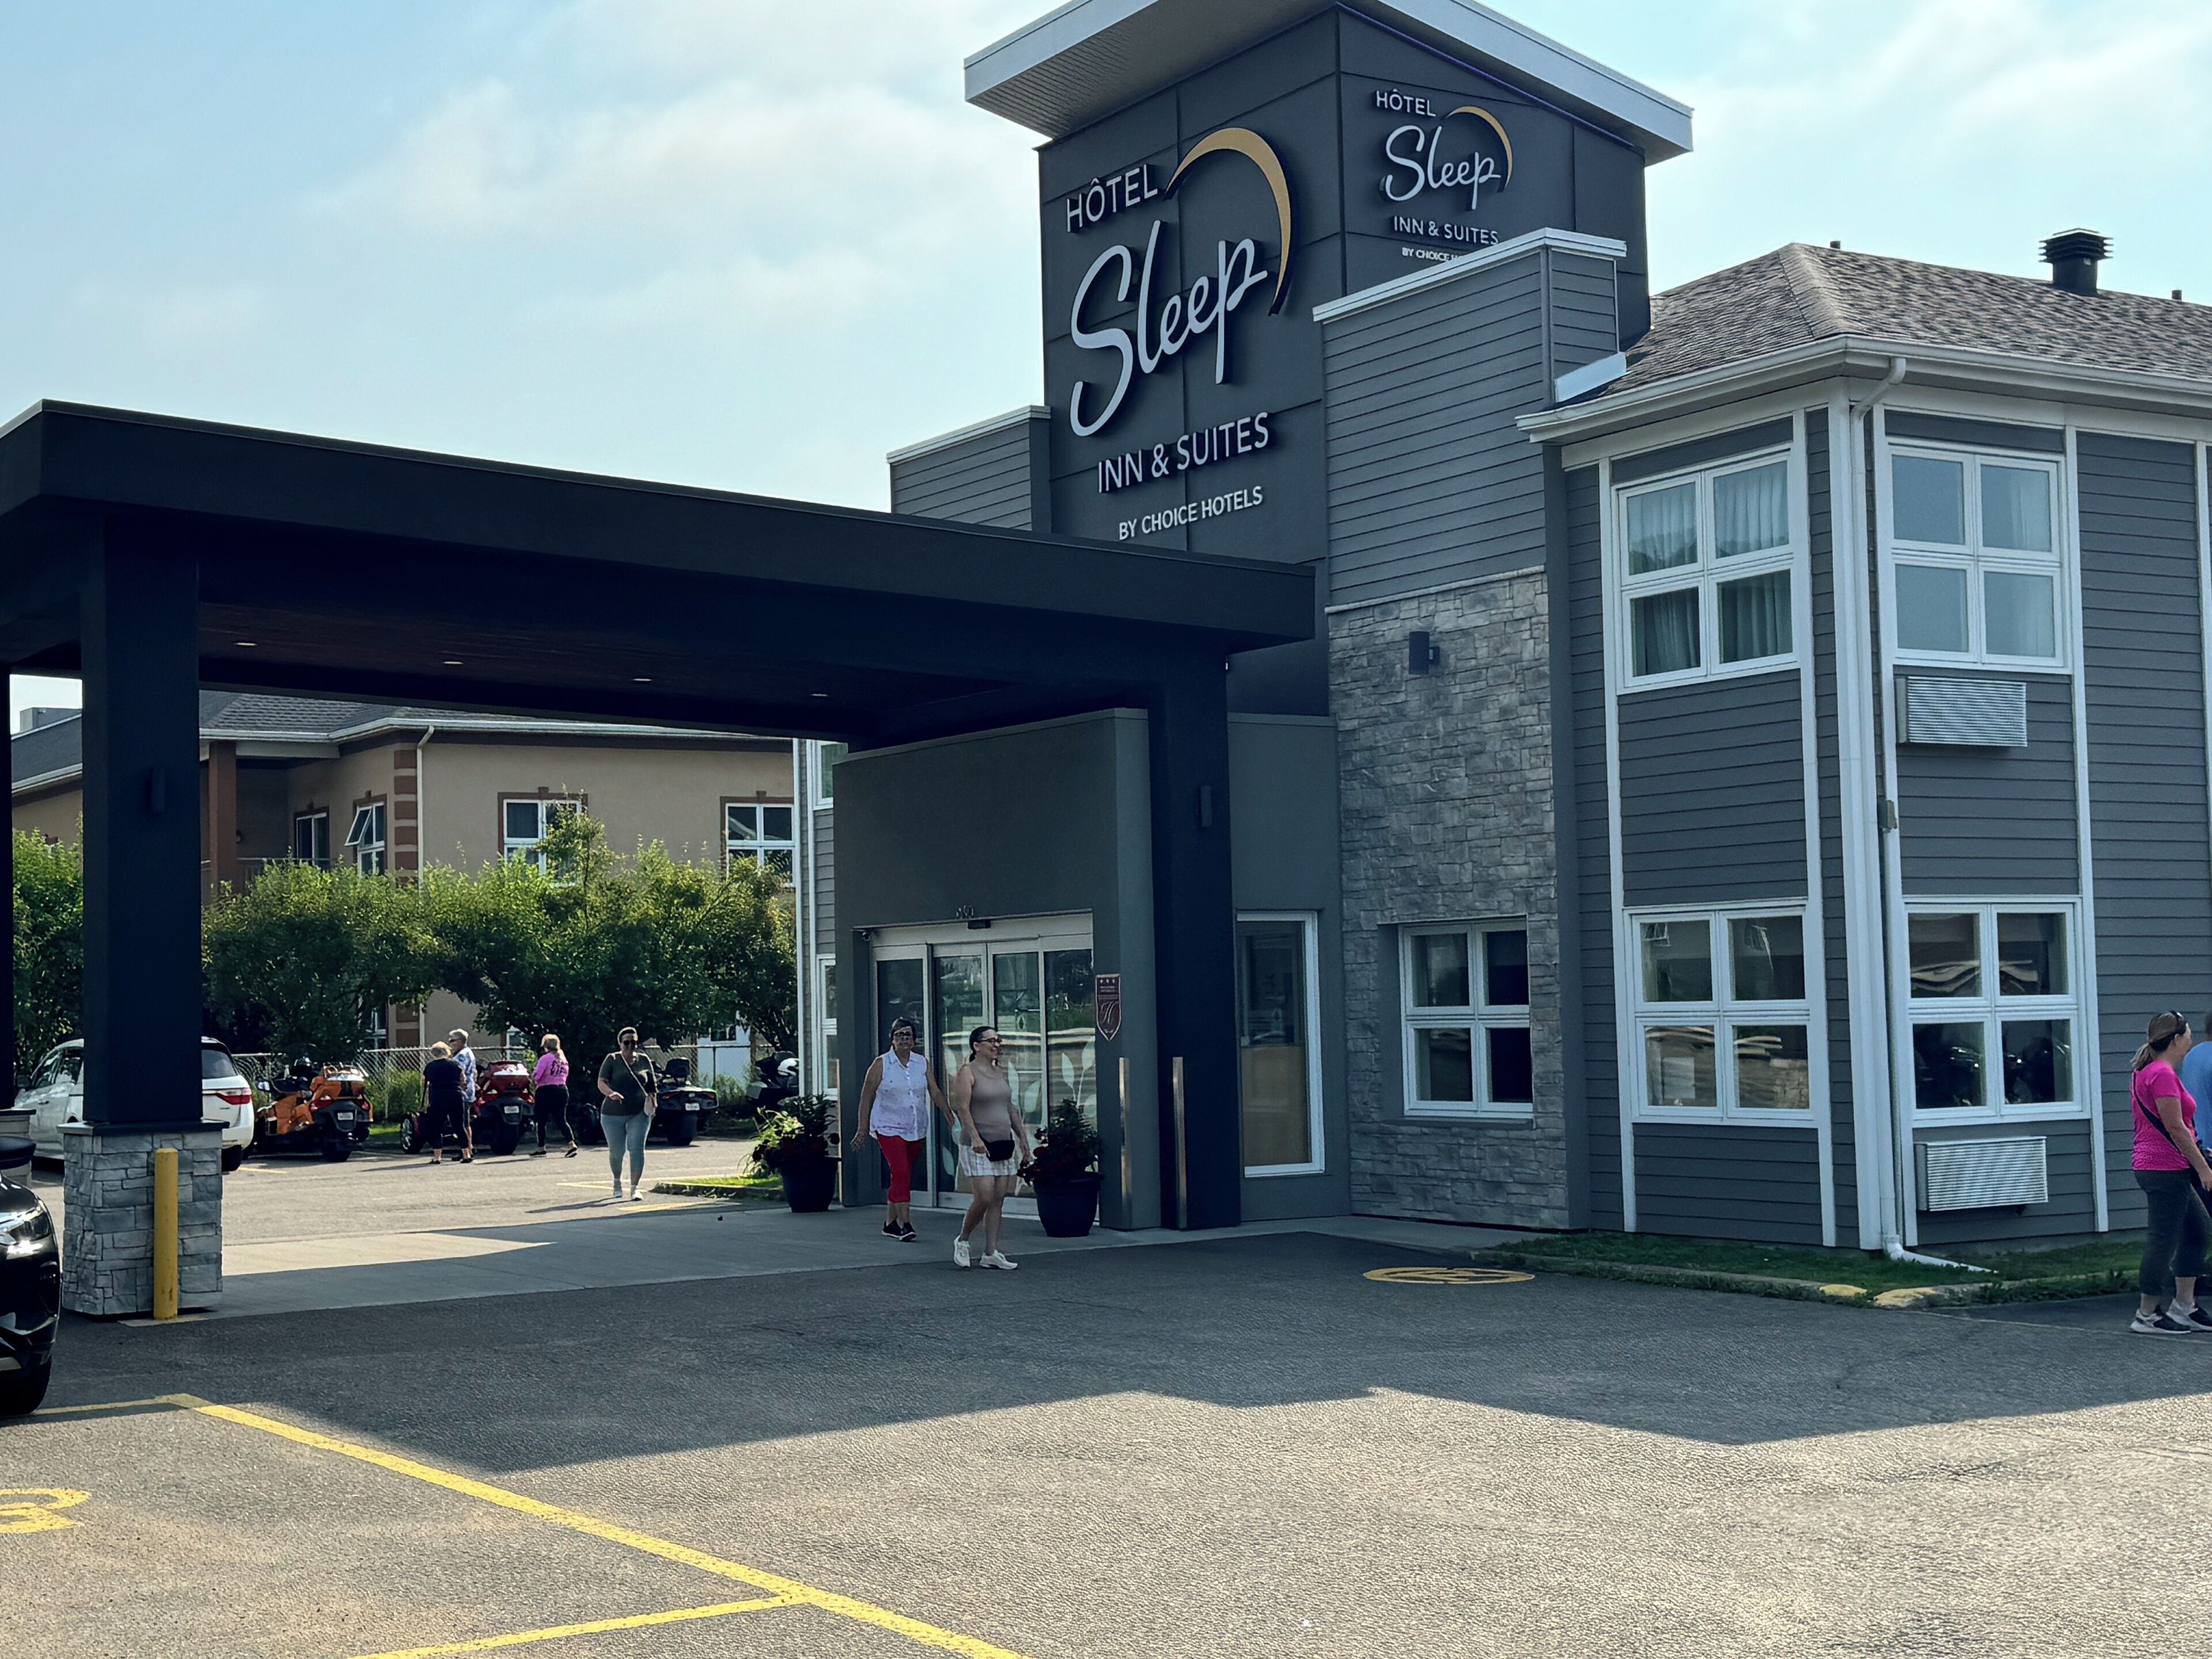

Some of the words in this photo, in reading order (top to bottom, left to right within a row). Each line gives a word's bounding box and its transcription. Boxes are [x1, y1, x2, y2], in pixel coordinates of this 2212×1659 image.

[1376, 88, 1437, 117] HÔTEL
[1067, 163, 1158, 233] HÔTEL
[1385, 125, 1502, 210] Sleep
[1394, 215, 1423, 235] INN
[1428, 221, 1440, 237] &
[1444, 224, 1499, 245] SUITES
[1402, 247, 1414, 257] BY
[1070, 219, 1267, 437] Sleep
[1099, 449, 1143, 494] INN
[1152, 443, 1169, 478] &
[1177, 411, 1268, 471] SUITES
[1119, 518, 1137, 541] BY
[1141, 502, 1198, 534] CHOICE
[1202, 485, 1263, 519] HOTELS
